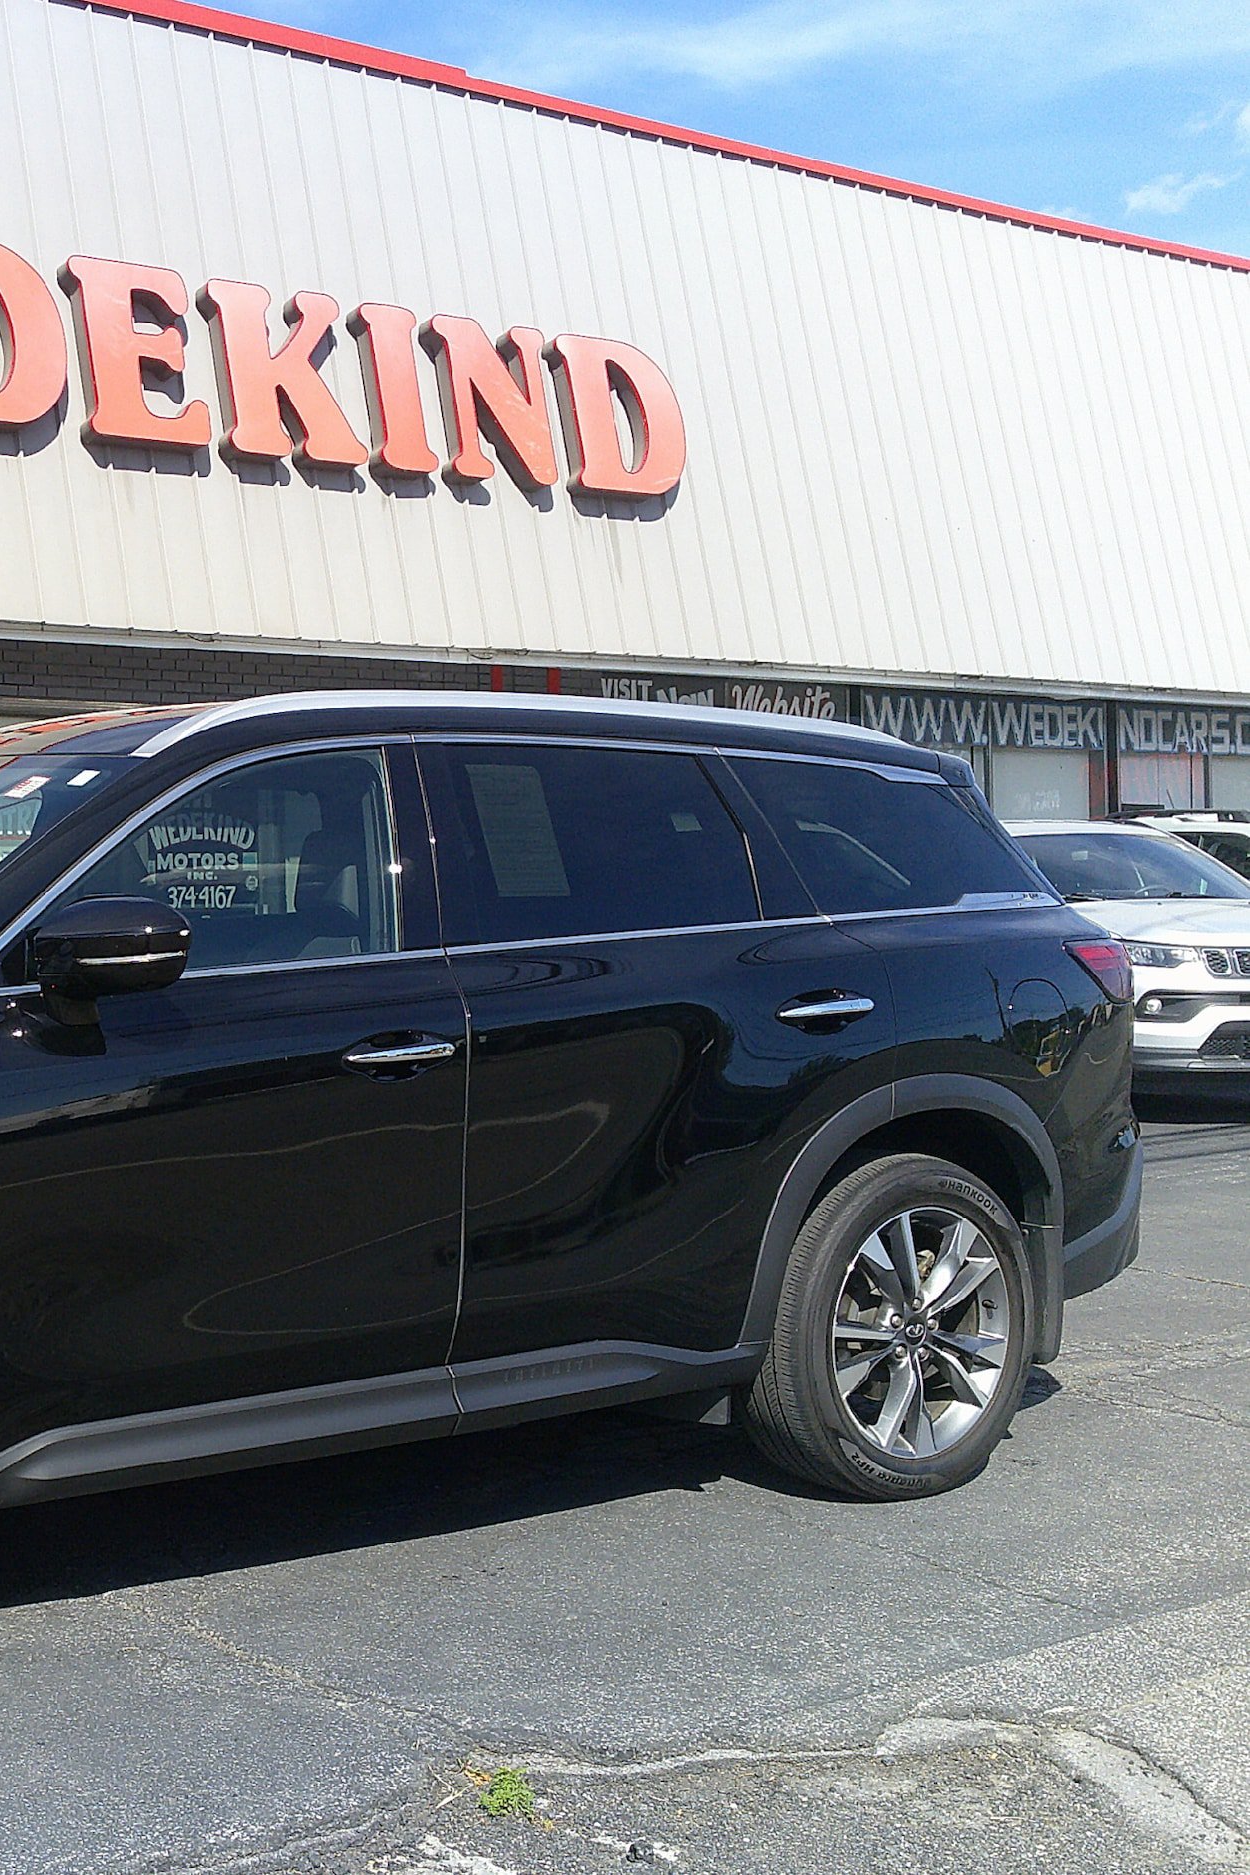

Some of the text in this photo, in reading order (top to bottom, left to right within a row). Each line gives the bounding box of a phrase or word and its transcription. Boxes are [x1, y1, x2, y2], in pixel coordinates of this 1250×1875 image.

[600, 677, 653, 702] VISIT
[156, 852, 239, 870] MOTORS
[187, 871, 218, 880] INC.
